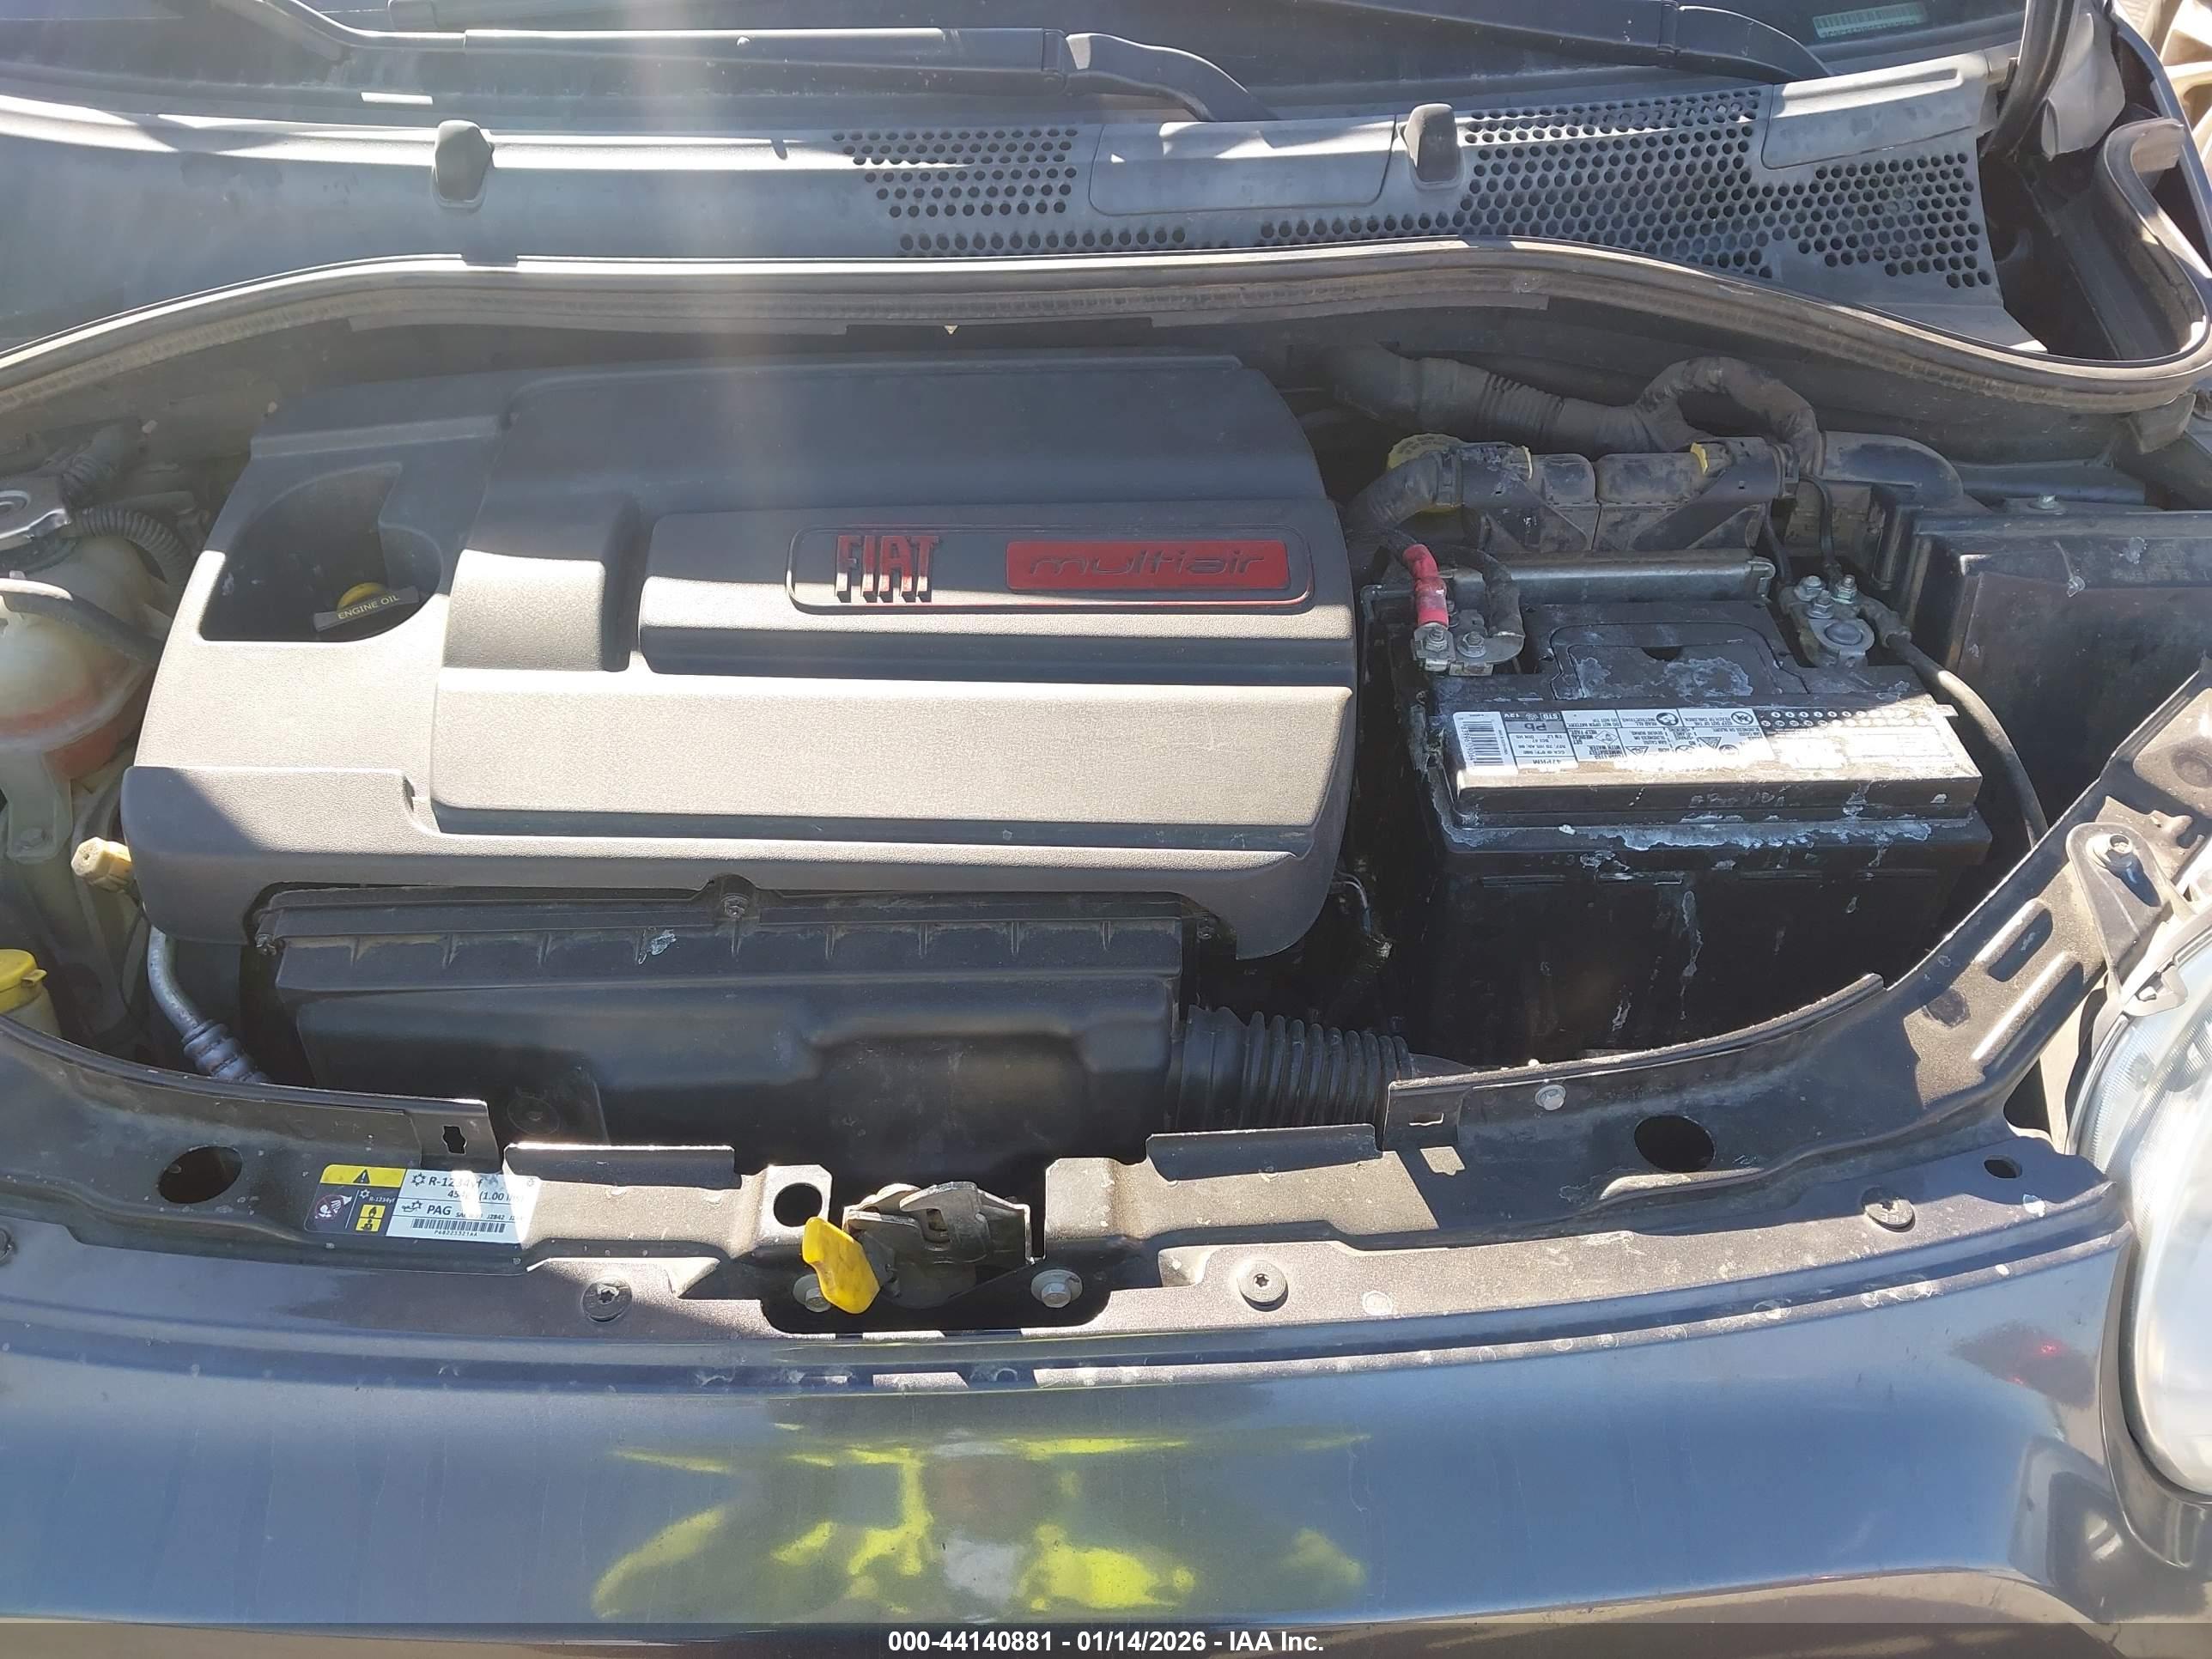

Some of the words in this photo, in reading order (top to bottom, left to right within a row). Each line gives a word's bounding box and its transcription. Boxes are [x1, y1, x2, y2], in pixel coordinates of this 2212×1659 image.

[836, 536, 939, 602] FIAT
[1030, 549, 1265, 577] multiair
[337, 601, 379, 619] ENGINE
[380, 594, 400, 605] OIL
[478, 1191, 504, 1201] (1.00
[426, 1204, 452, 1216] PAG
